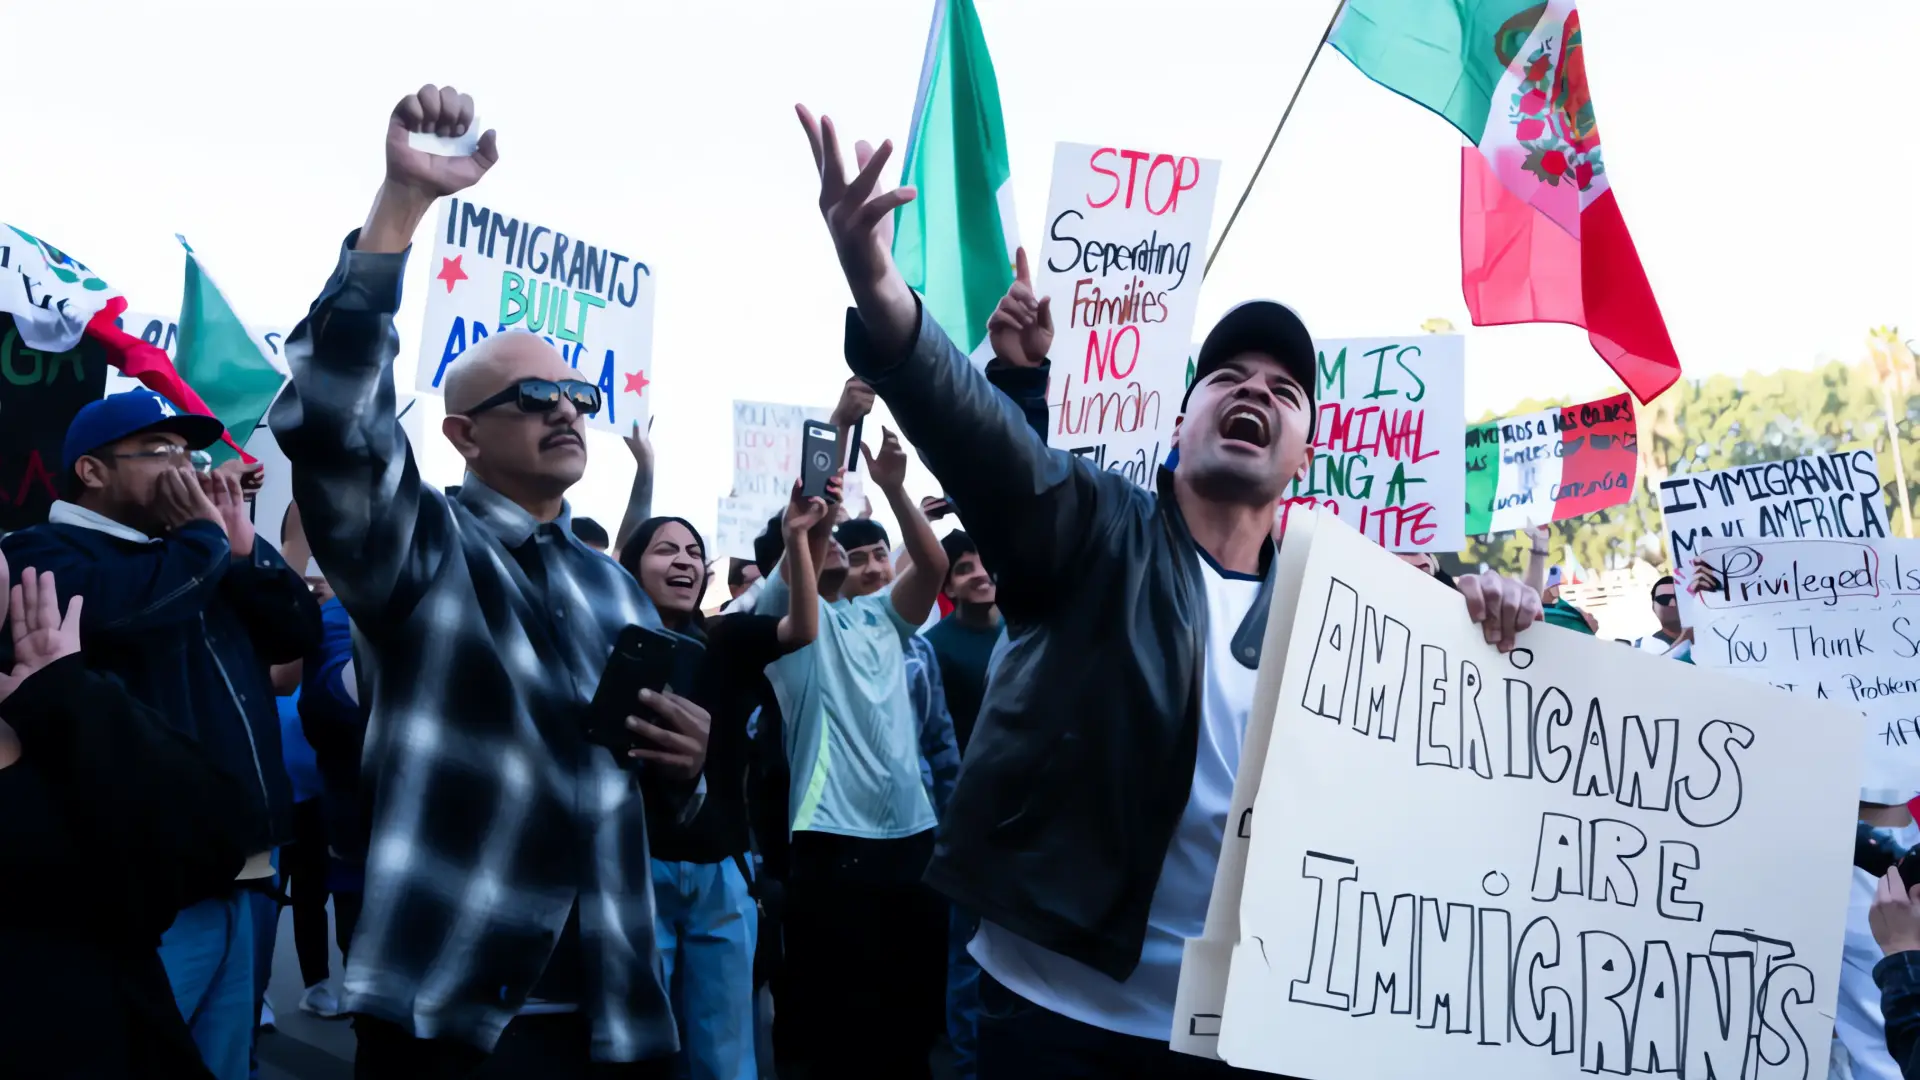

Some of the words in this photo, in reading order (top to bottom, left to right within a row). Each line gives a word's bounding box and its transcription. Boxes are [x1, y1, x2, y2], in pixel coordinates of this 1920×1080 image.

[1086, 147, 1200, 216] STOP
[446, 197, 650, 308] IMMIGRANTS
[1047, 209, 1192, 291] Seperating
[500, 270, 606, 343] BUILT
[1070, 275, 1168, 329] Families
[1083, 325, 1140, 384] NO
[1363, 344, 1426, 402] IS
[1660, 450, 1881, 514] IMMIGRANTS
[1721, 549, 1874, 606] Privileged
[1776, 624, 1875, 661] Think
[1301, 576, 1755, 828] AMERICANS
[1531, 812, 1704, 922] ARE
[1288, 849, 1815, 1080] IMMIGRANTS
